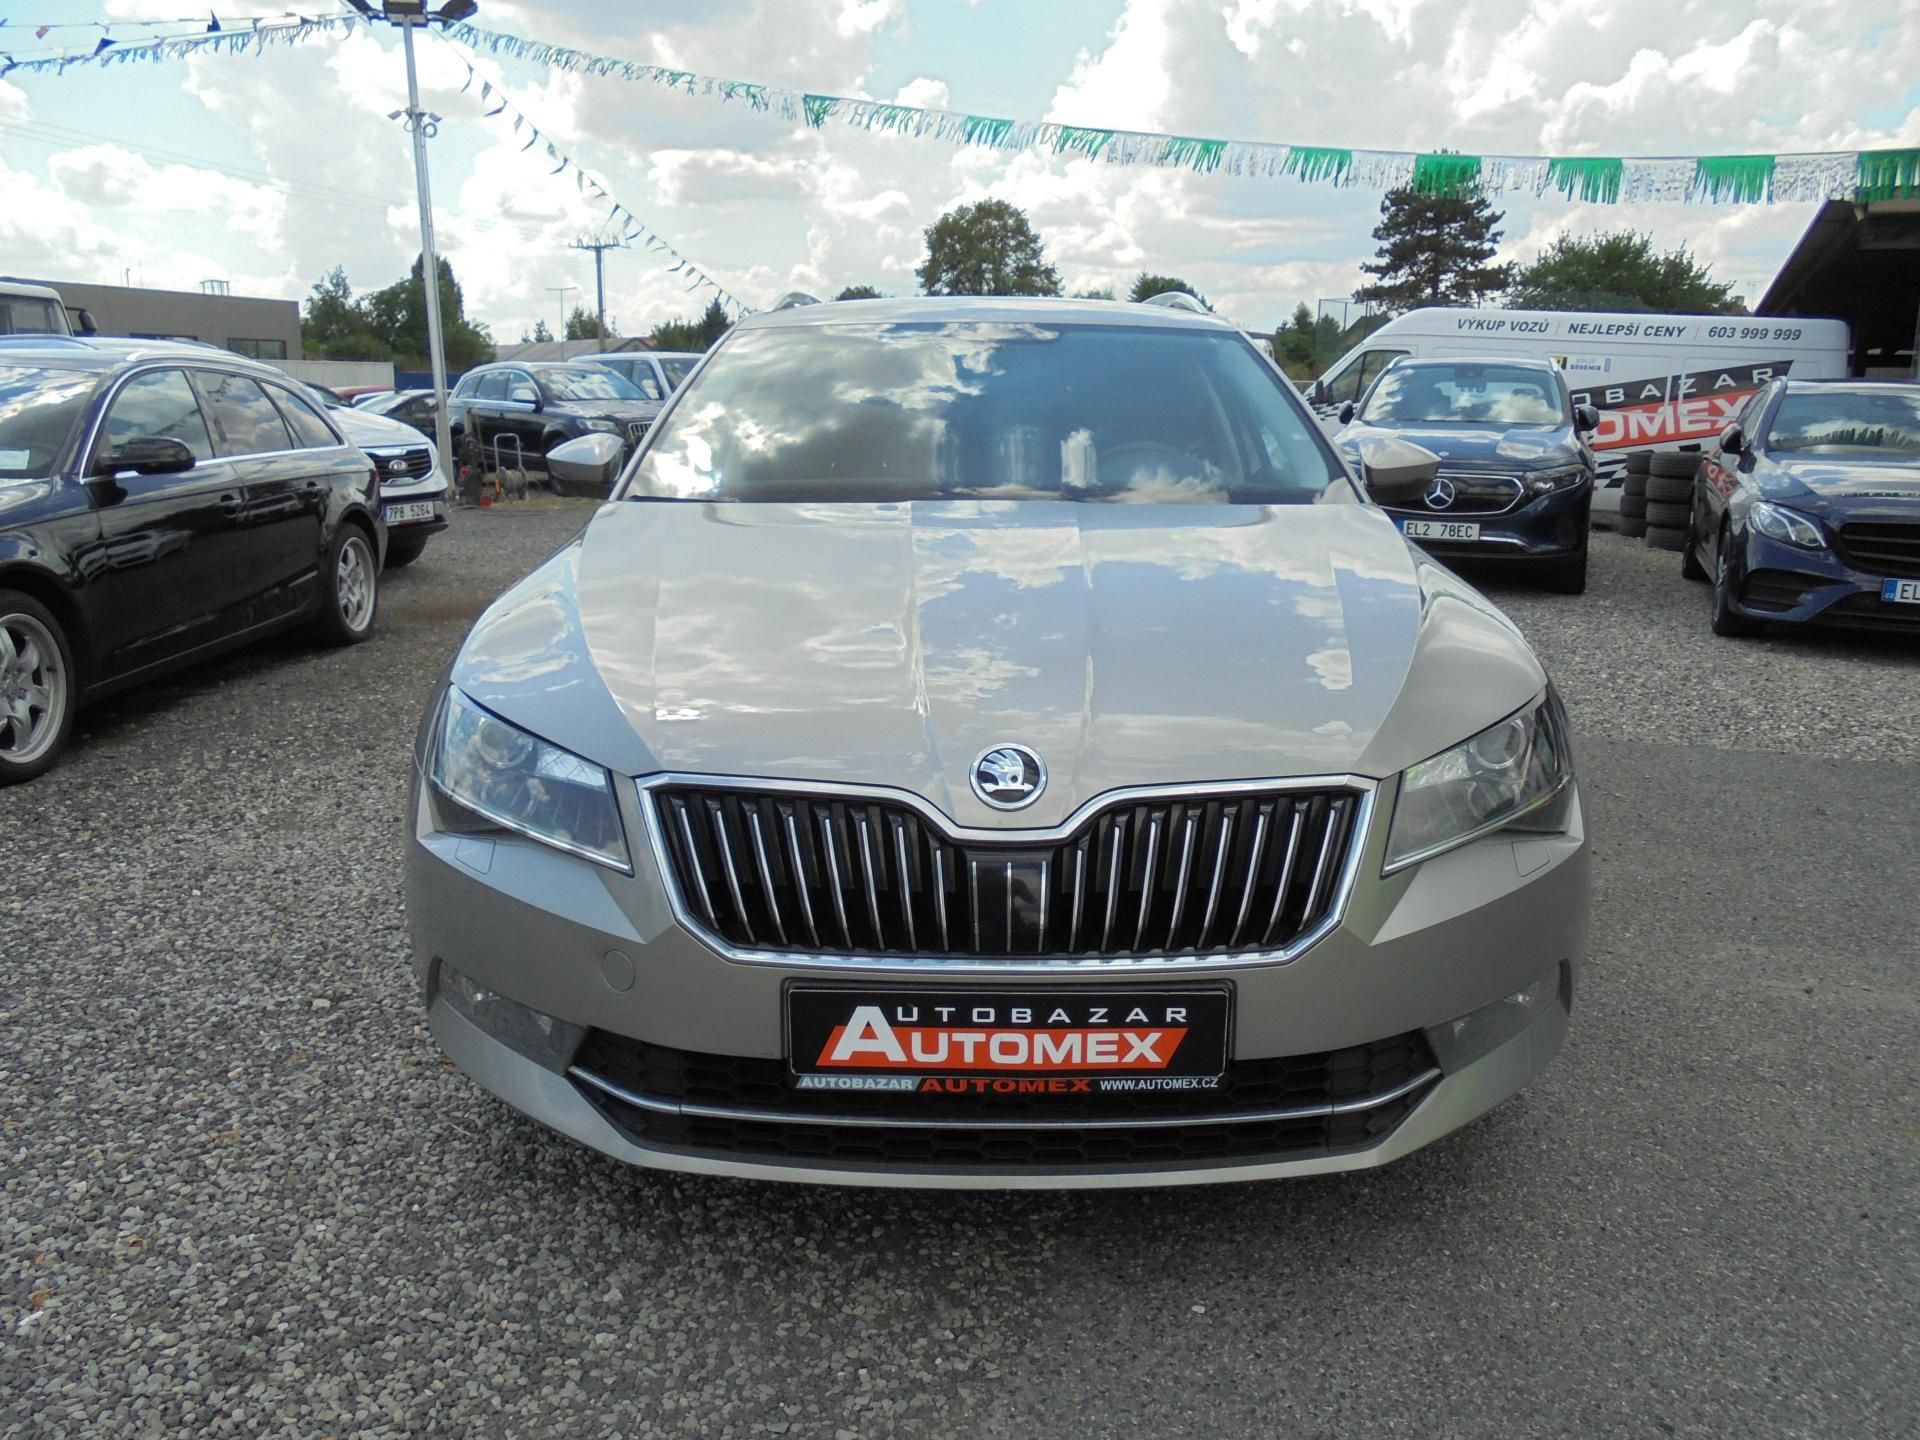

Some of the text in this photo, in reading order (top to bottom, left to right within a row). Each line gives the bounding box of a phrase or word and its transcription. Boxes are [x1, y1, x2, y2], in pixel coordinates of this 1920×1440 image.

[1457, 316, 1505, 331] VÝKUP
[1567, 322, 1640, 336] NEJLEPŠÍ
[1643, 325, 1688, 338] CENY
[1708, 326, 1737, 338] 603
[1740, 328, 1769, 340] 999
[1772, 329, 1802, 341] 999
[1406, 522, 1473, 538] EL2 78EC
[831, 1005, 1163, 1064] AUTOMEX
[801, 1076, 1219, 1094] AUTOBAZAR AUTOMEX WWW.AUTOMEX.CZ
